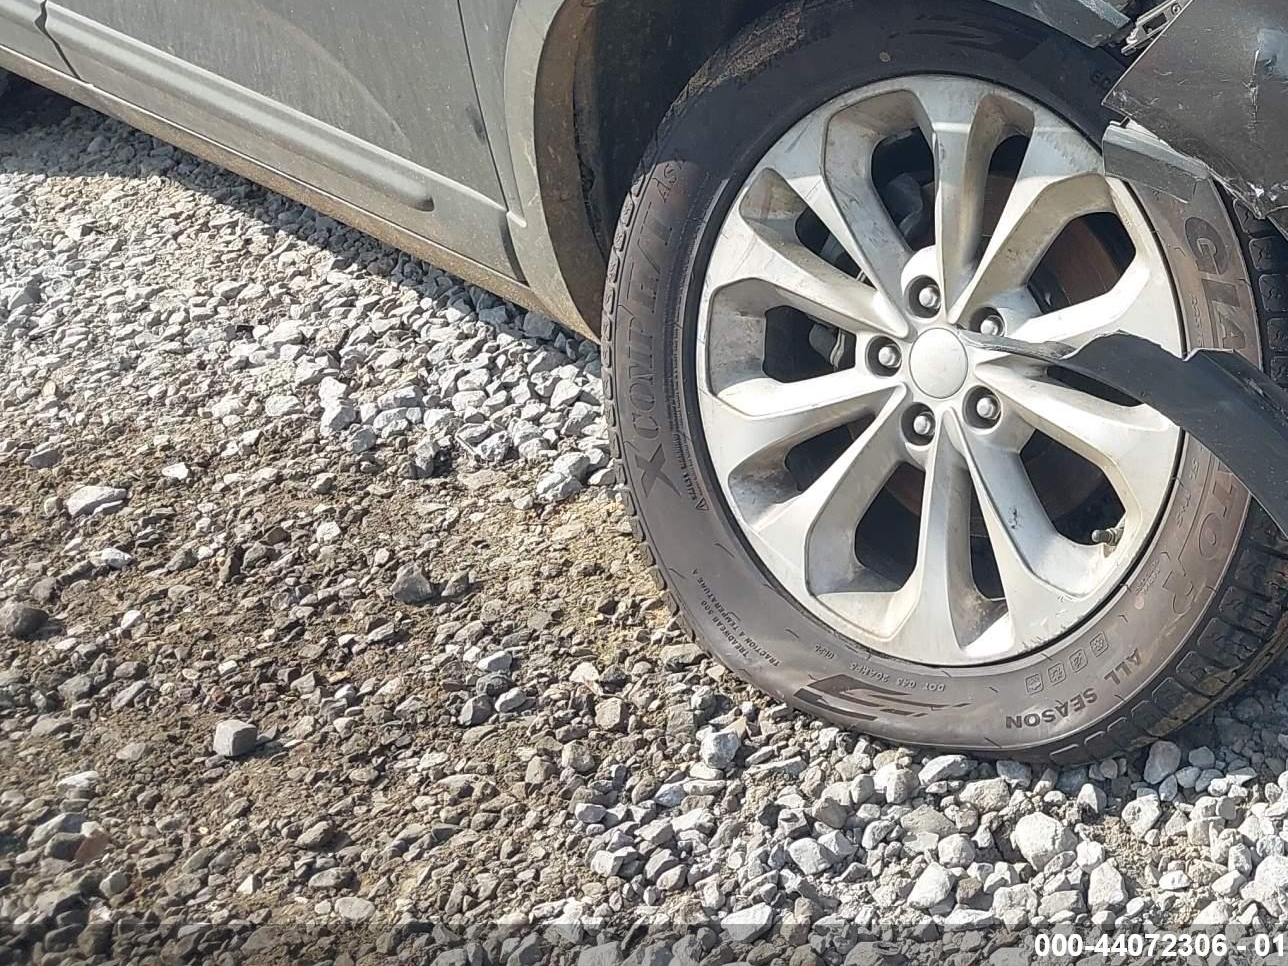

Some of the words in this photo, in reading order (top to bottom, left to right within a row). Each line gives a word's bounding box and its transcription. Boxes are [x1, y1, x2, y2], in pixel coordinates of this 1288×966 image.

[696, 577, 739, 632] TEMPERATURE
[744, 636, 780, 668] TRACTION
[1104, 648, 1143, 685] ALL
[1005, 687, 1099, 729] SEASON
